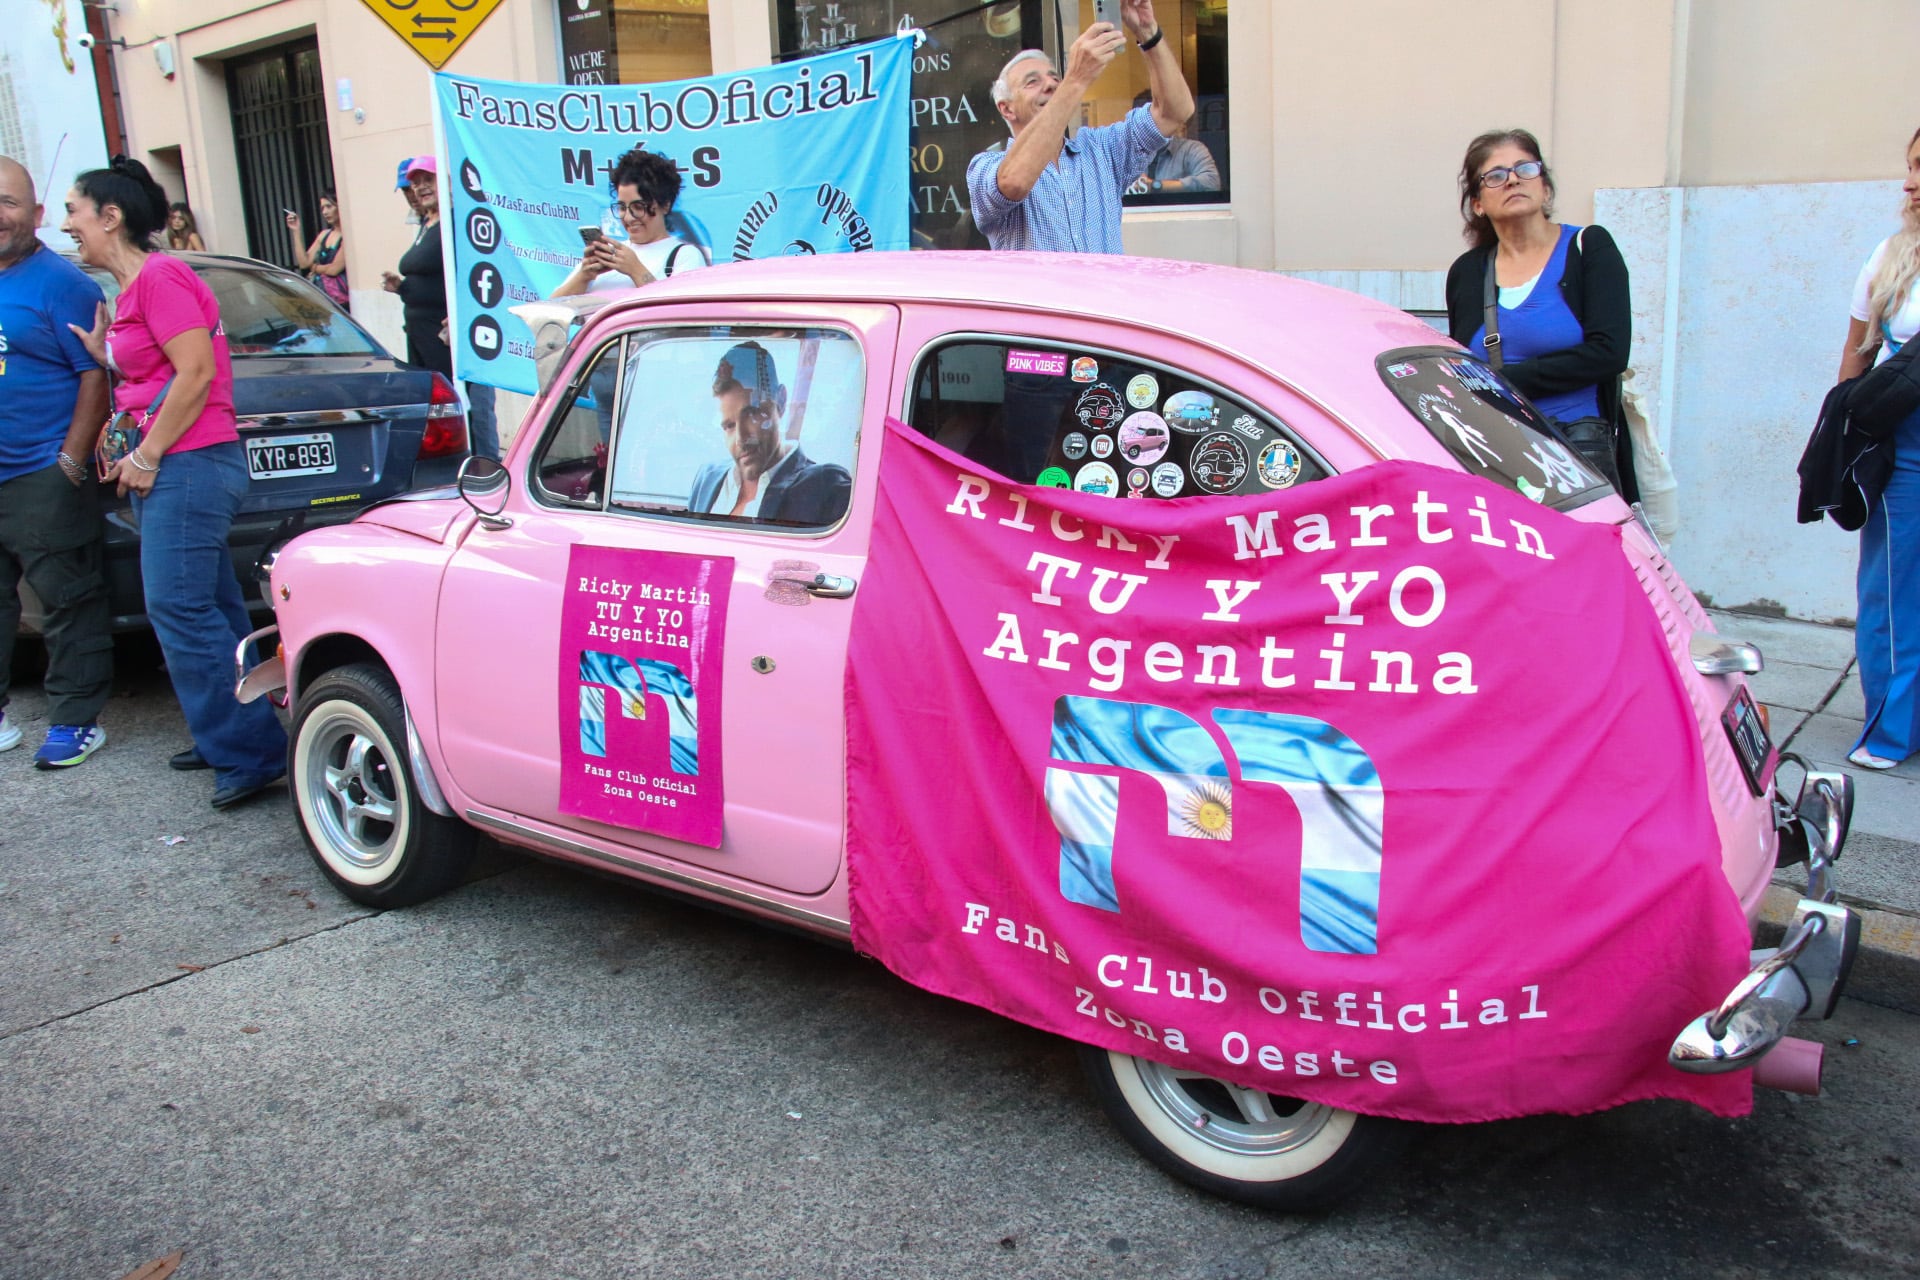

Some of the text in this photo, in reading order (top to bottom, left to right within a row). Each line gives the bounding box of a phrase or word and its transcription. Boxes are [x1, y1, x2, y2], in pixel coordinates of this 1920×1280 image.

[569, 50, 606, 70] WE'RE
[450, 53, 877, 133] FansClubOficial
[732, 191, 777, 263] cuand
[1009, 357, 1063, 373] PINK VIBES
[251, 444, 332, 471] KYR 893
[1226, 490, 1555, 561] Martin
[578, 577, 711, 607] Ricky Martin
[1026, 552, 1447, 628] TU Y YO
[596, 601, 684, 629] TU Y YO
[587, 621, 690, 649] Argentina
[983, 612, 1479, 696] Argentina
[584, 763, 697, 796] Fans Club Oficial
[603, 783, 677, 808] Zona Oeste
[961, 902, 1548, 1033] Fans Club Official
[1075, 986, 1398, 1086] Zona Oeste
